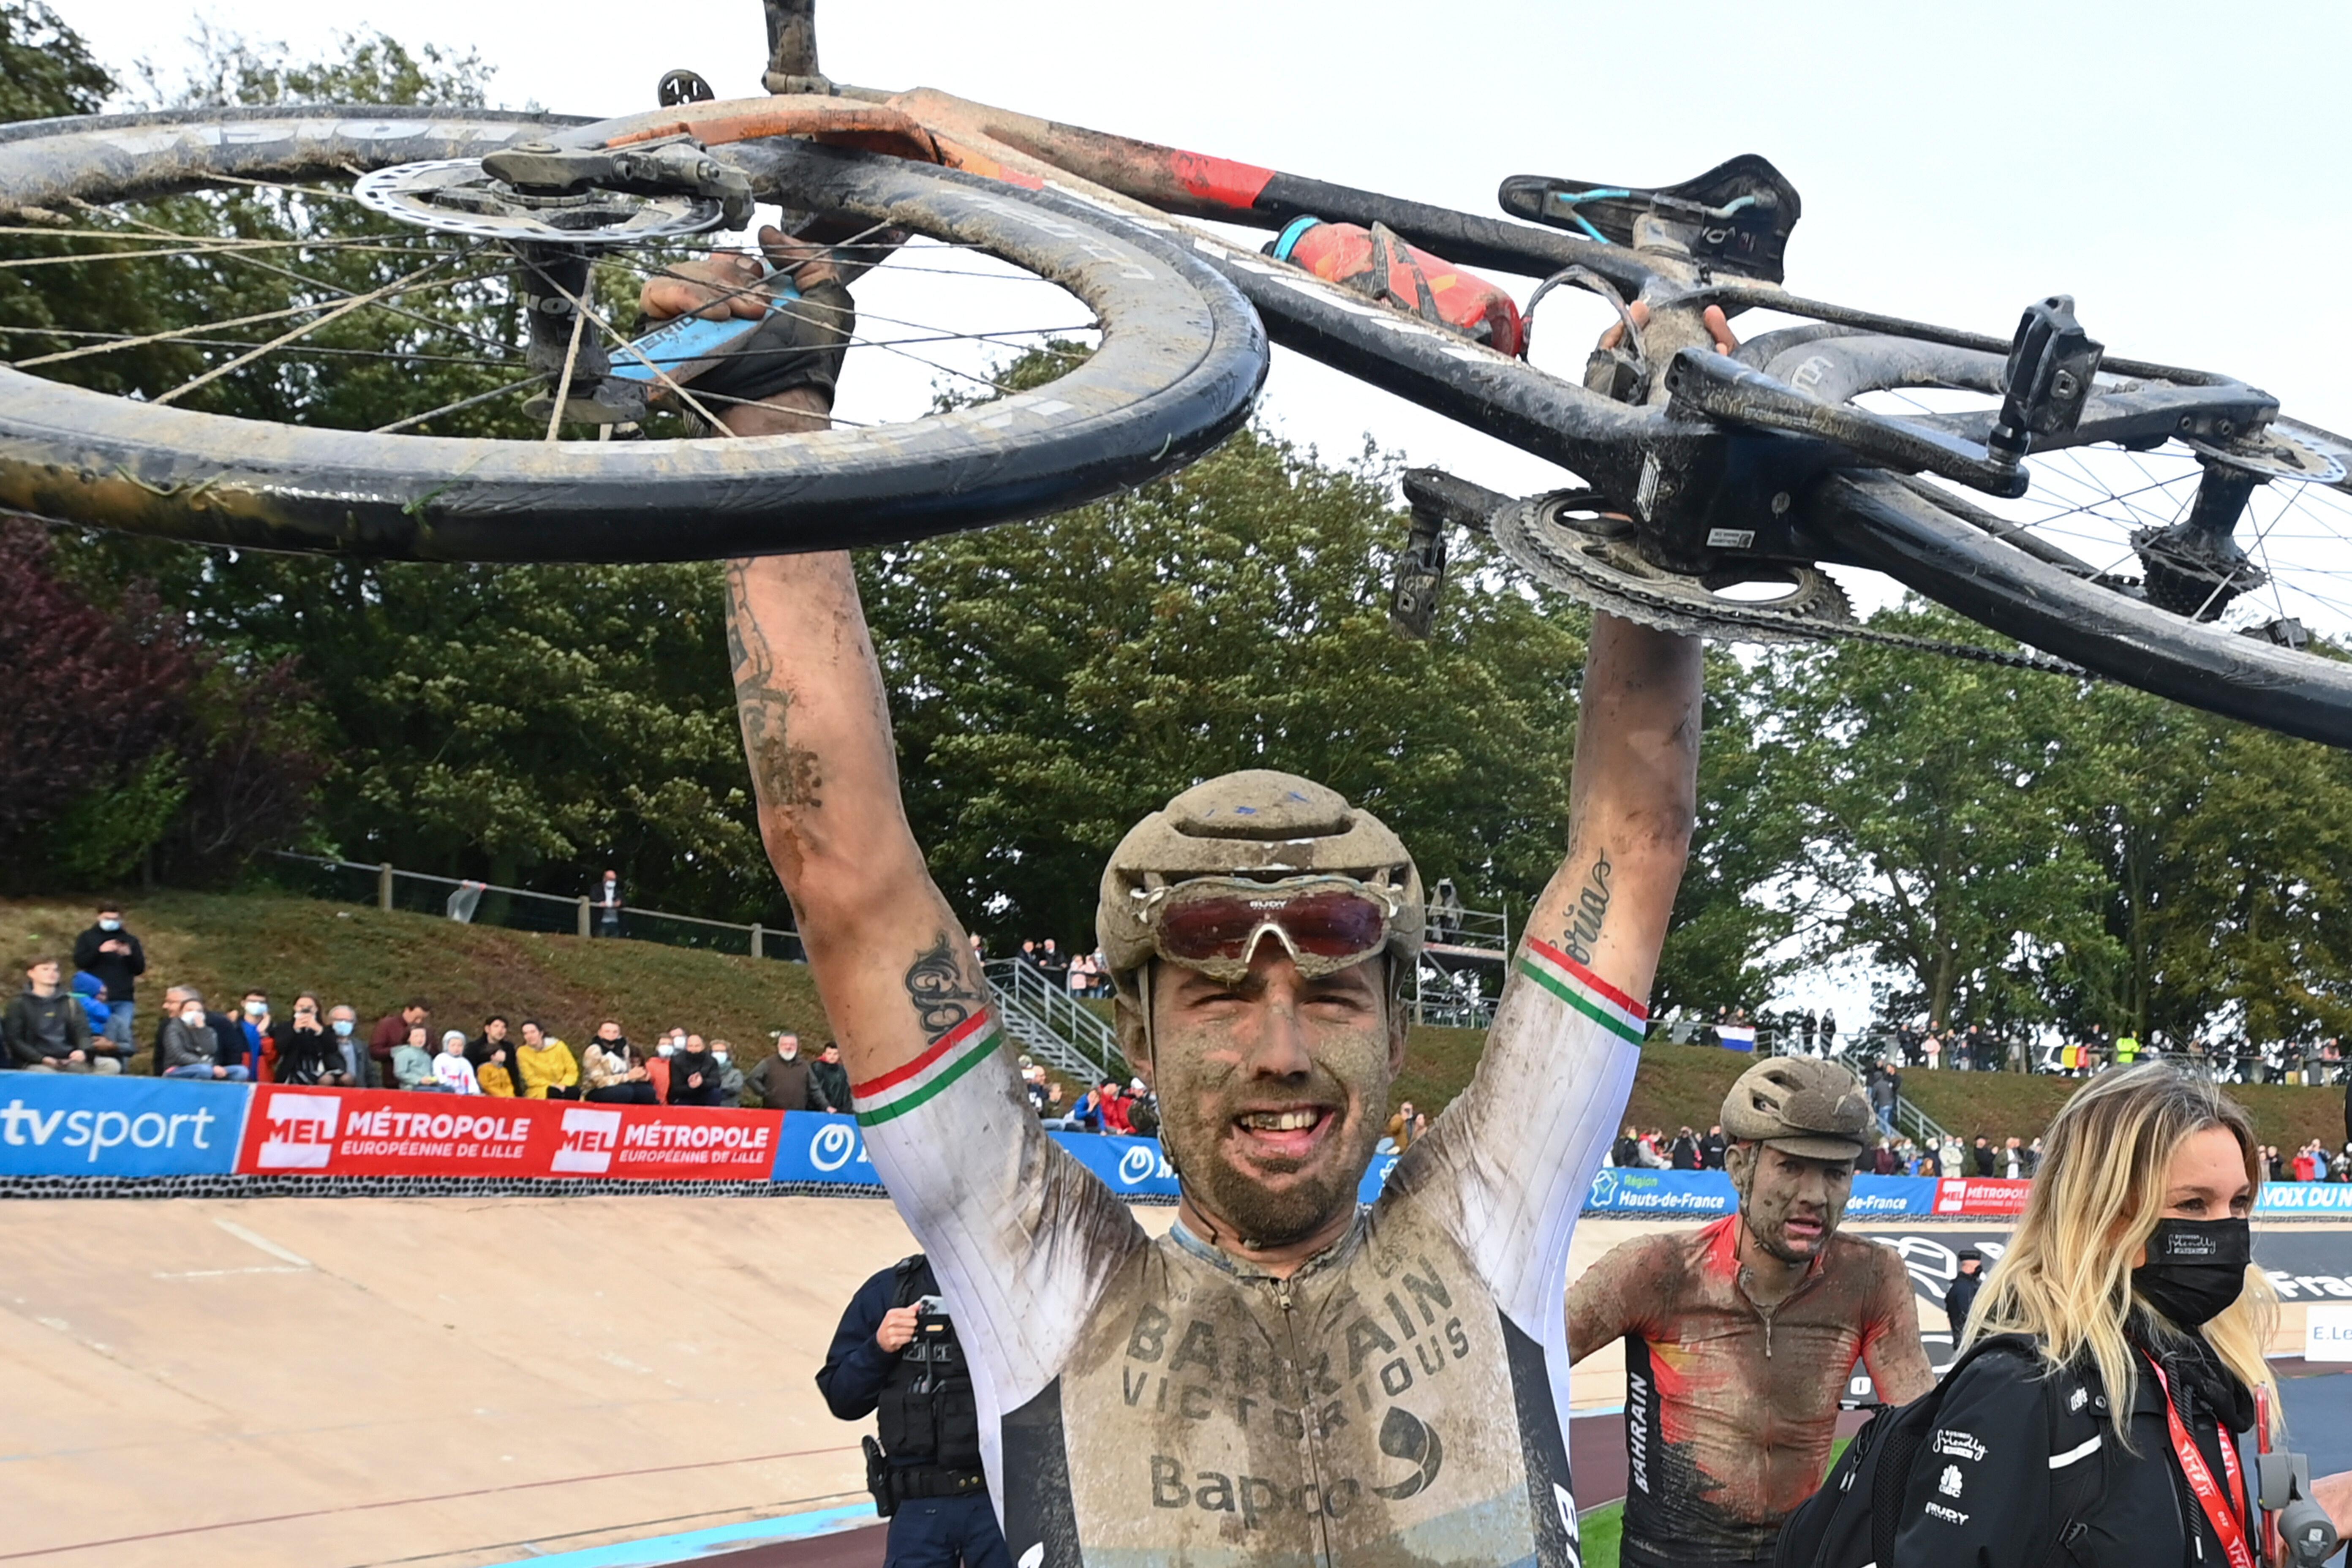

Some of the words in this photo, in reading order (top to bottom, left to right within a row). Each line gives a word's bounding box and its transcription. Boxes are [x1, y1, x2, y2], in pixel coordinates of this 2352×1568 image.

[617, 316, 699, 363] MERID
[1563, 847, 1612, 966] oria
[344, 1105, 531, 1141] MÉTROPOLE
[623, 1119, 770, 1149] MÉTROPOLE
[340, 1140, 453, 1157] EUROPÉENNE
[456, 1143, 478, 1157] DE
[481, 1144, 525, 1159] LILLE
[618, 1149, 708, 1164] EUROPÉENNE
[711, 1151, 727, 1163] DE
[730, 1152, 765, 1164] LILLE
[1618, 1190, 1725, 1209] Hauts-de-France
[2263, 1186, 2308, 1207] VOIX
[2307, 1186, 2338, 1207] DU
[2265, 1271, 2352, 1298] Fra
[1630, 1372, 1650, 1494] BAHRAIN
[1150, 1454, 1361, 1530] Bapco
